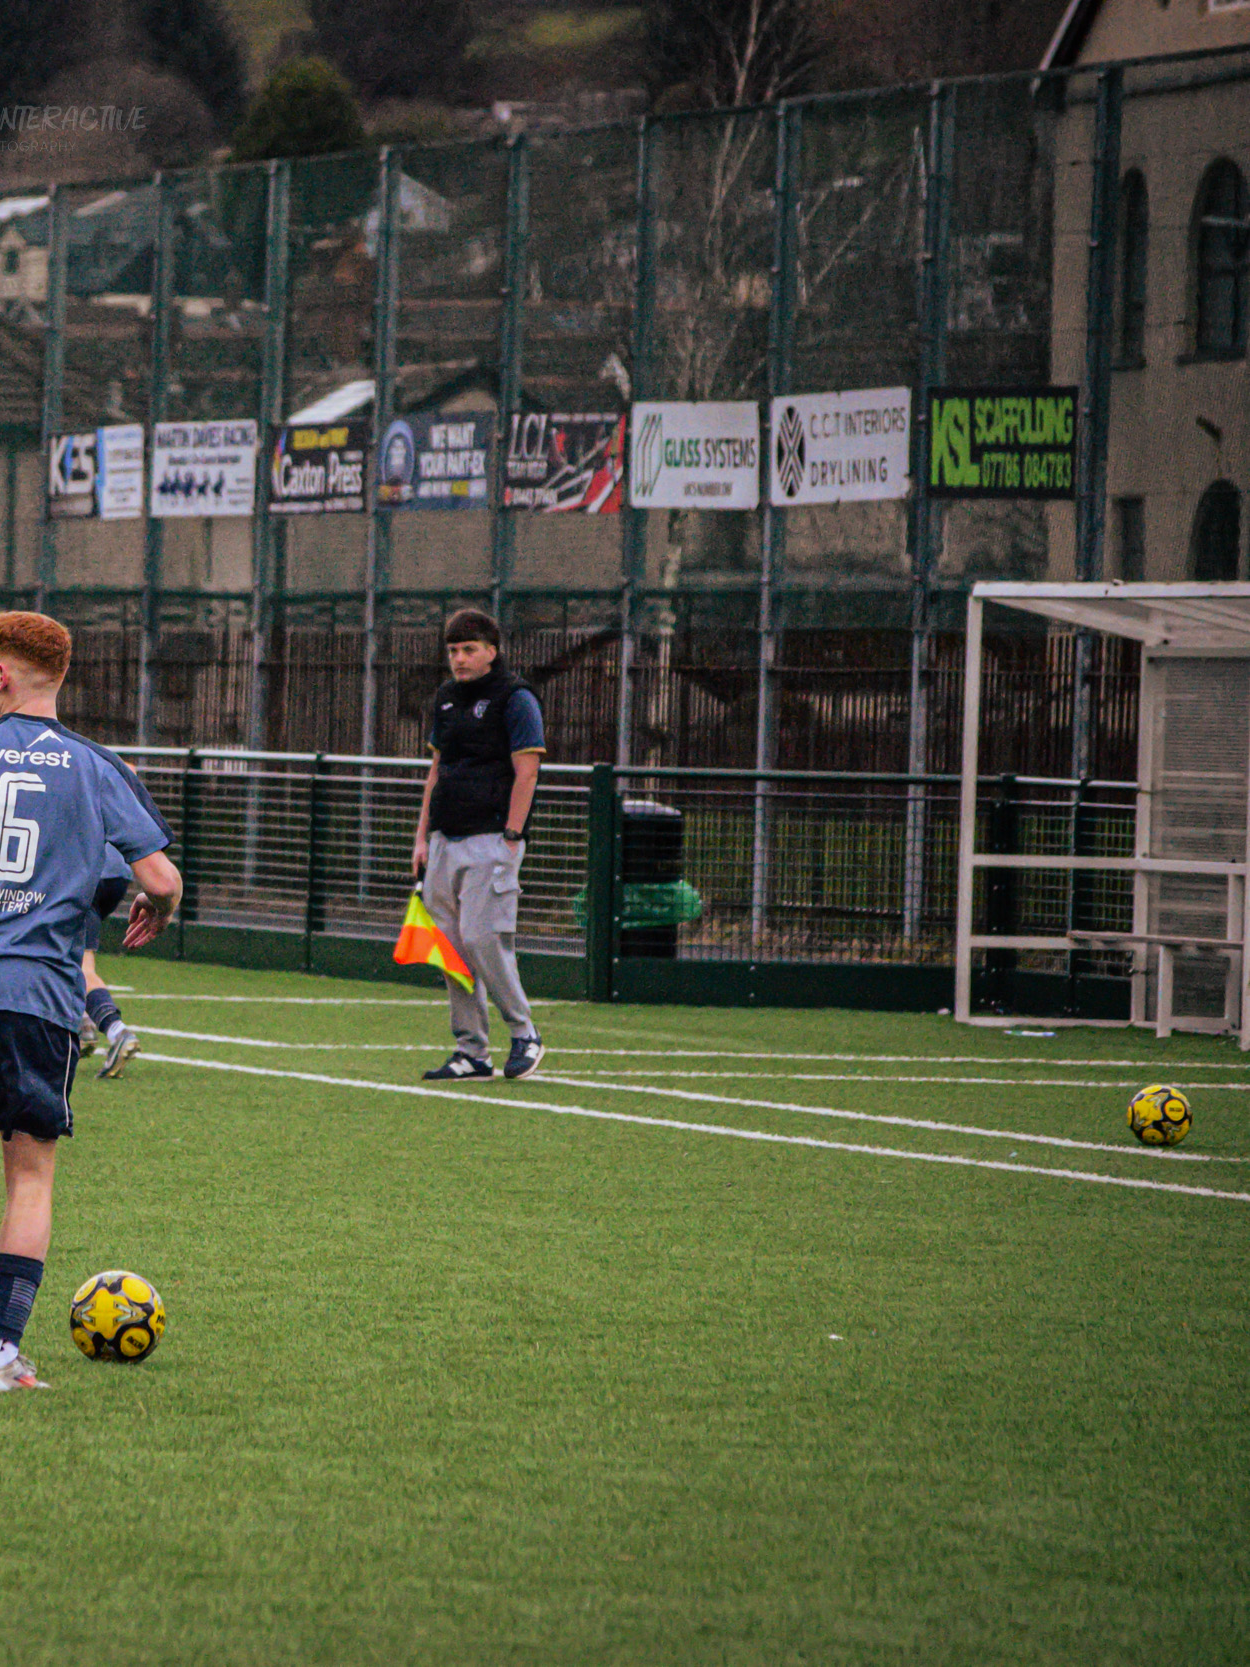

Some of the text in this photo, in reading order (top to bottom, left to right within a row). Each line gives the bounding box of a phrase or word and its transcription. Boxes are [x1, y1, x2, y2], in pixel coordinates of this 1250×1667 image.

[508, 414, 548, 459] LCL
[844, 406, 907, 437] INTERIORS
[931, 397, 980, 487] KSL
[975, 397, 1073, 445] SCAFFOLDING
[280, 454, 325, 496] Caxton
[328, 451, 363, 494] Press
[664, 438, 756, 469] GLASS SYSTEMS
[810, 457, 888, 487] DRYLINING
